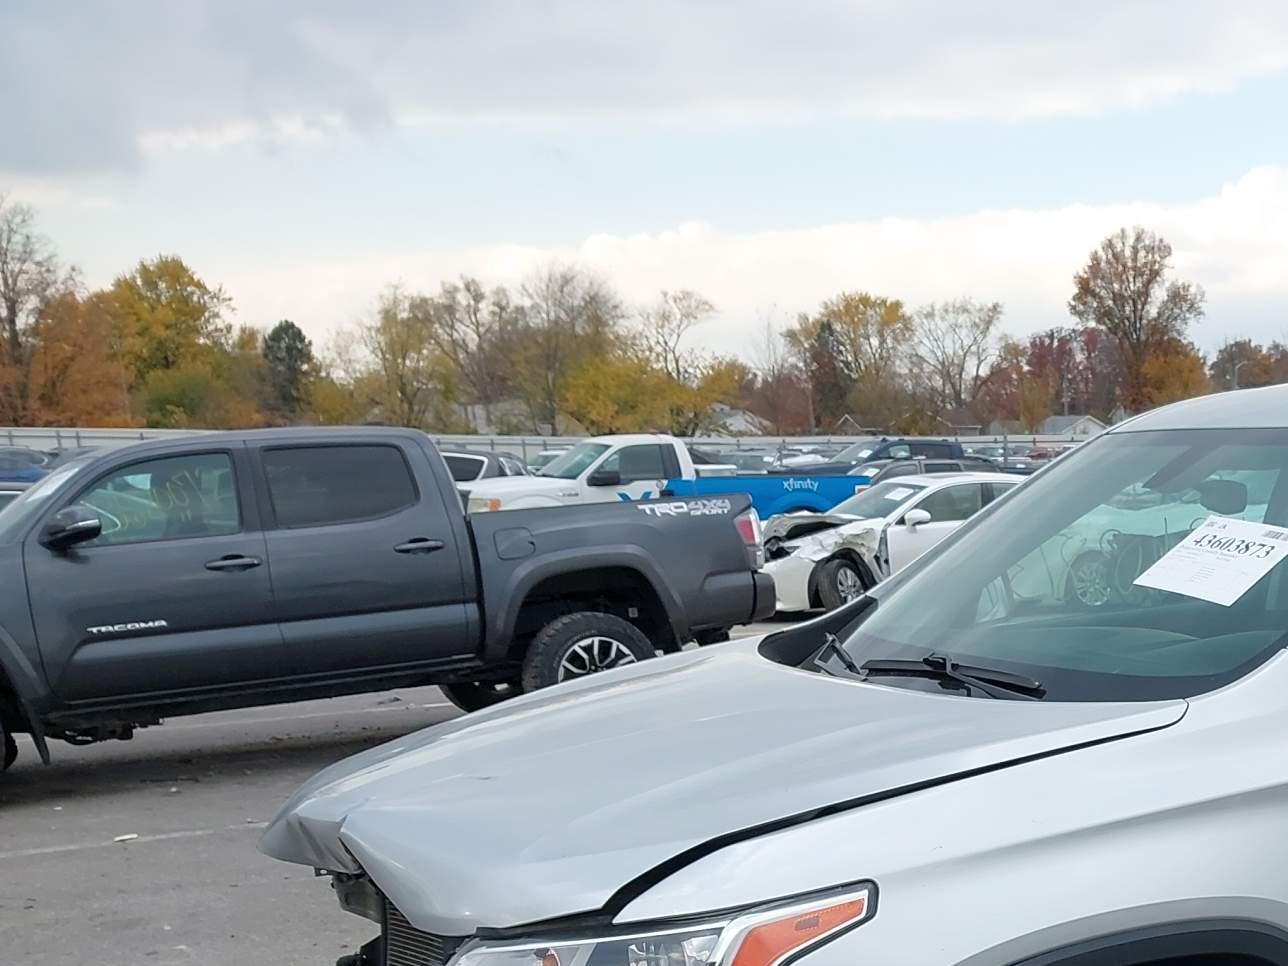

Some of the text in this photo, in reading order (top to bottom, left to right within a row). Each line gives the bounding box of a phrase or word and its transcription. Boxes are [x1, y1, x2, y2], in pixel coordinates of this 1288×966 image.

[782, 477, 820, 491] xfinity
[690, 508, 729, 516] SPORT
[1192, 532, 1277, 559] 43603873
[86, 619, 168, 634] TACOMA
